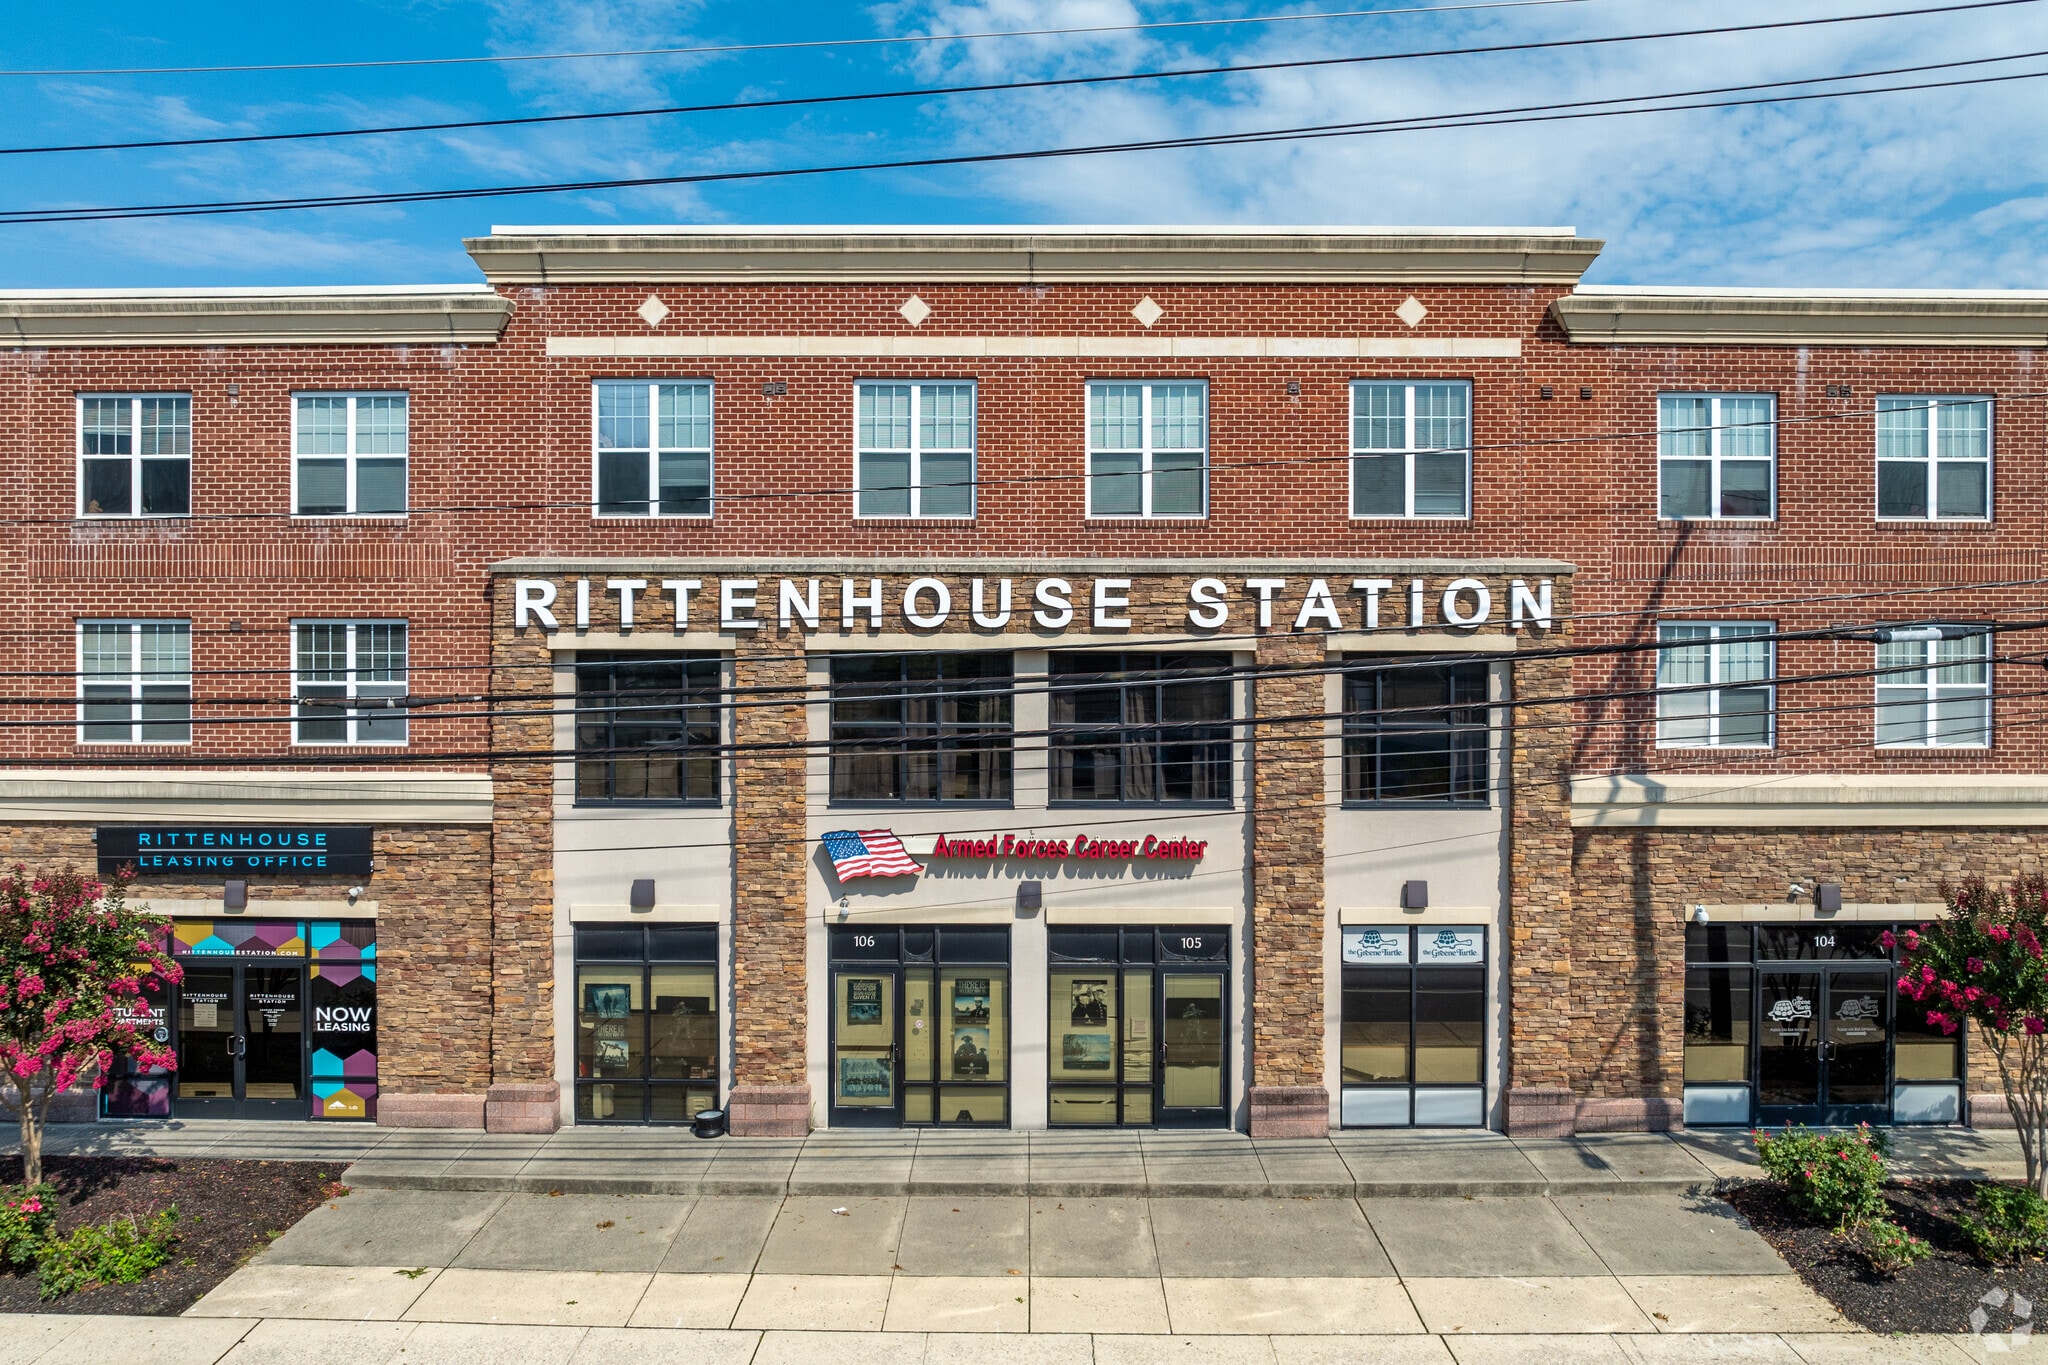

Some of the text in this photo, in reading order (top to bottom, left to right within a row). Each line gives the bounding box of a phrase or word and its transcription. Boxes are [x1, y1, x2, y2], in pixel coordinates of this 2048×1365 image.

[515, 578, 1552, 629] RITTENHOUSE STATION
[139, 833, 327, 846] RITTENHOUSE
[933, 834, 1208, 860] Armed Forces Career Center
[140, 855, 327, 867] LEASING OFFICE
[853, 935, 875, 947] 106
[1180, 937, 1202, 949] 105
[1813, 935, 1836, 947] 104
[1356, 949, 1381, 958] Greene
[1431, 949, 1456, 958] Greene
[315, 1006, 372, 1022] NOW
[317, 1022, 371, 1032] LEASING
